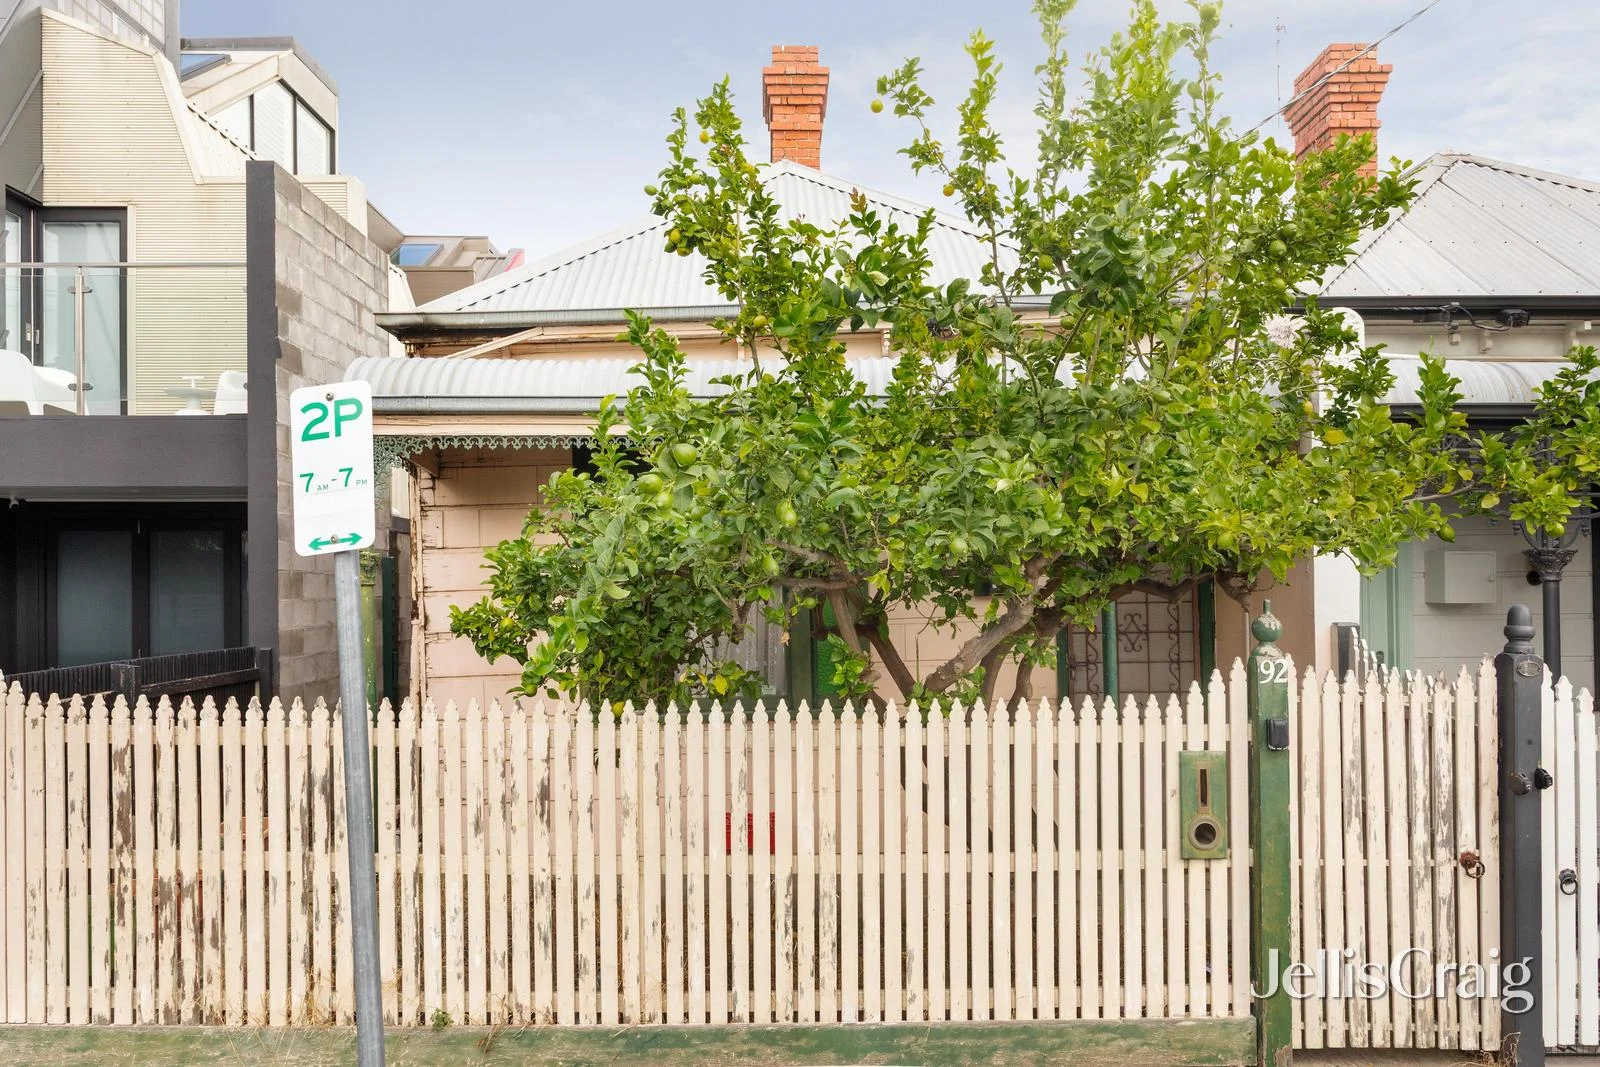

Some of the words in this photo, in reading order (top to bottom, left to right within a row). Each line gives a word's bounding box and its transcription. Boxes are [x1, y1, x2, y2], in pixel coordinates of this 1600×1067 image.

[301, 398, 363, 442] 2P
[299, 473, 314, 492] 7
[1260, 659, 1289, 684] 92
